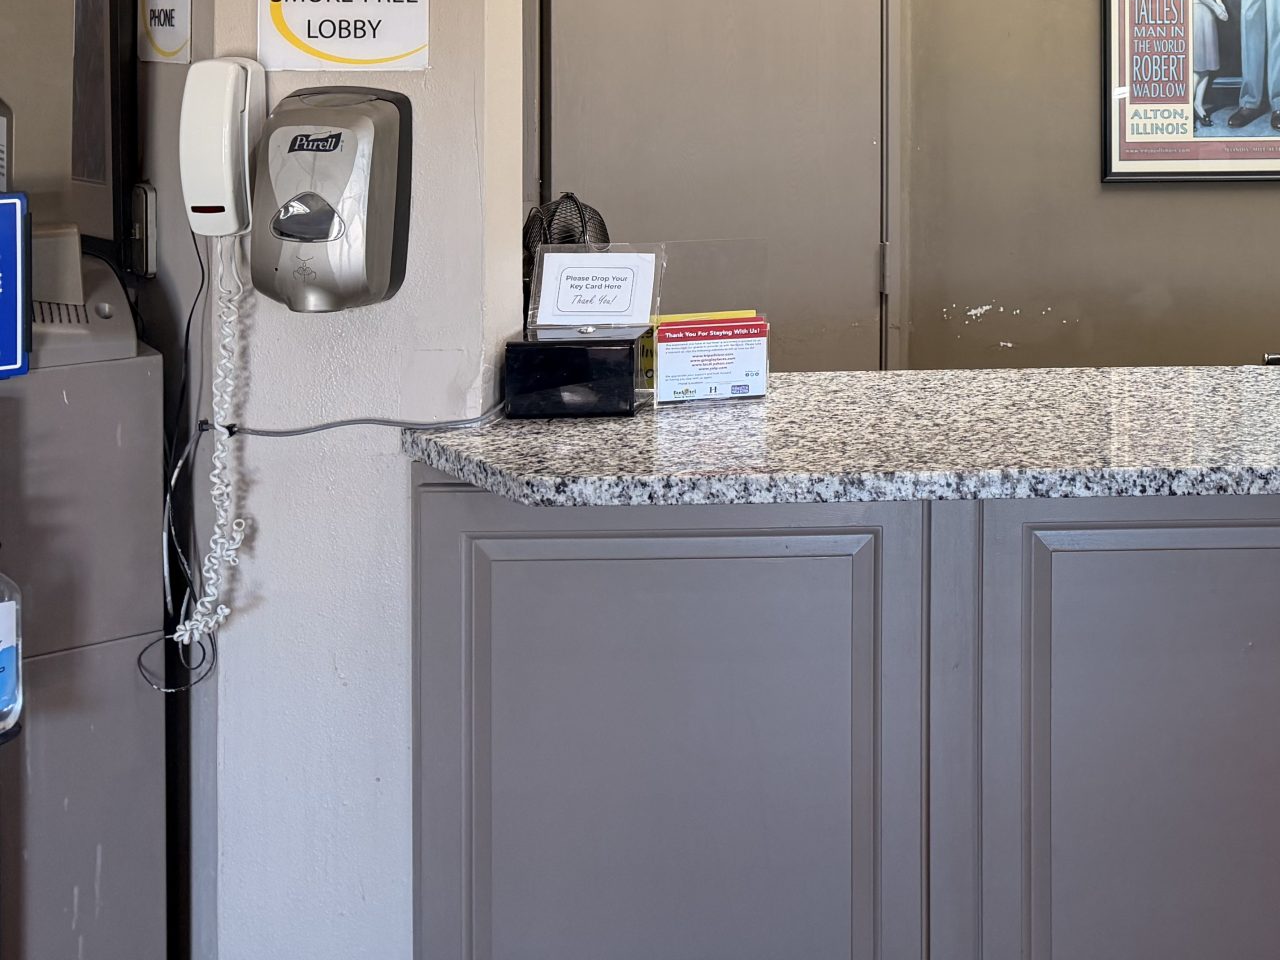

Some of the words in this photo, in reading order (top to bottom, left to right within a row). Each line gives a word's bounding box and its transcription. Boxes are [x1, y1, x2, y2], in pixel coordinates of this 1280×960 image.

[150, 9, 175, 27] PHONE
[307, 19, 382, 39] LOBBY
[1134, 27, 1167, 37] MAN
[1172, 27, 1184, 37] IN
[1134, 40, 1151, 53] THE
[1154, 39, 1186, 53] WORLD
[1133, 56, 1186, 82] ROBERT
[1133, 83, 1186, 98] WADLOW
[1131, 109, 1189, 120] ALTON,
[1131, 123, 1188, 135] ILLINOIS
[294, 135, 336, 152] Purell
[571, 295, 596, 305] Thank
[599, 295, 617, 305] You!
